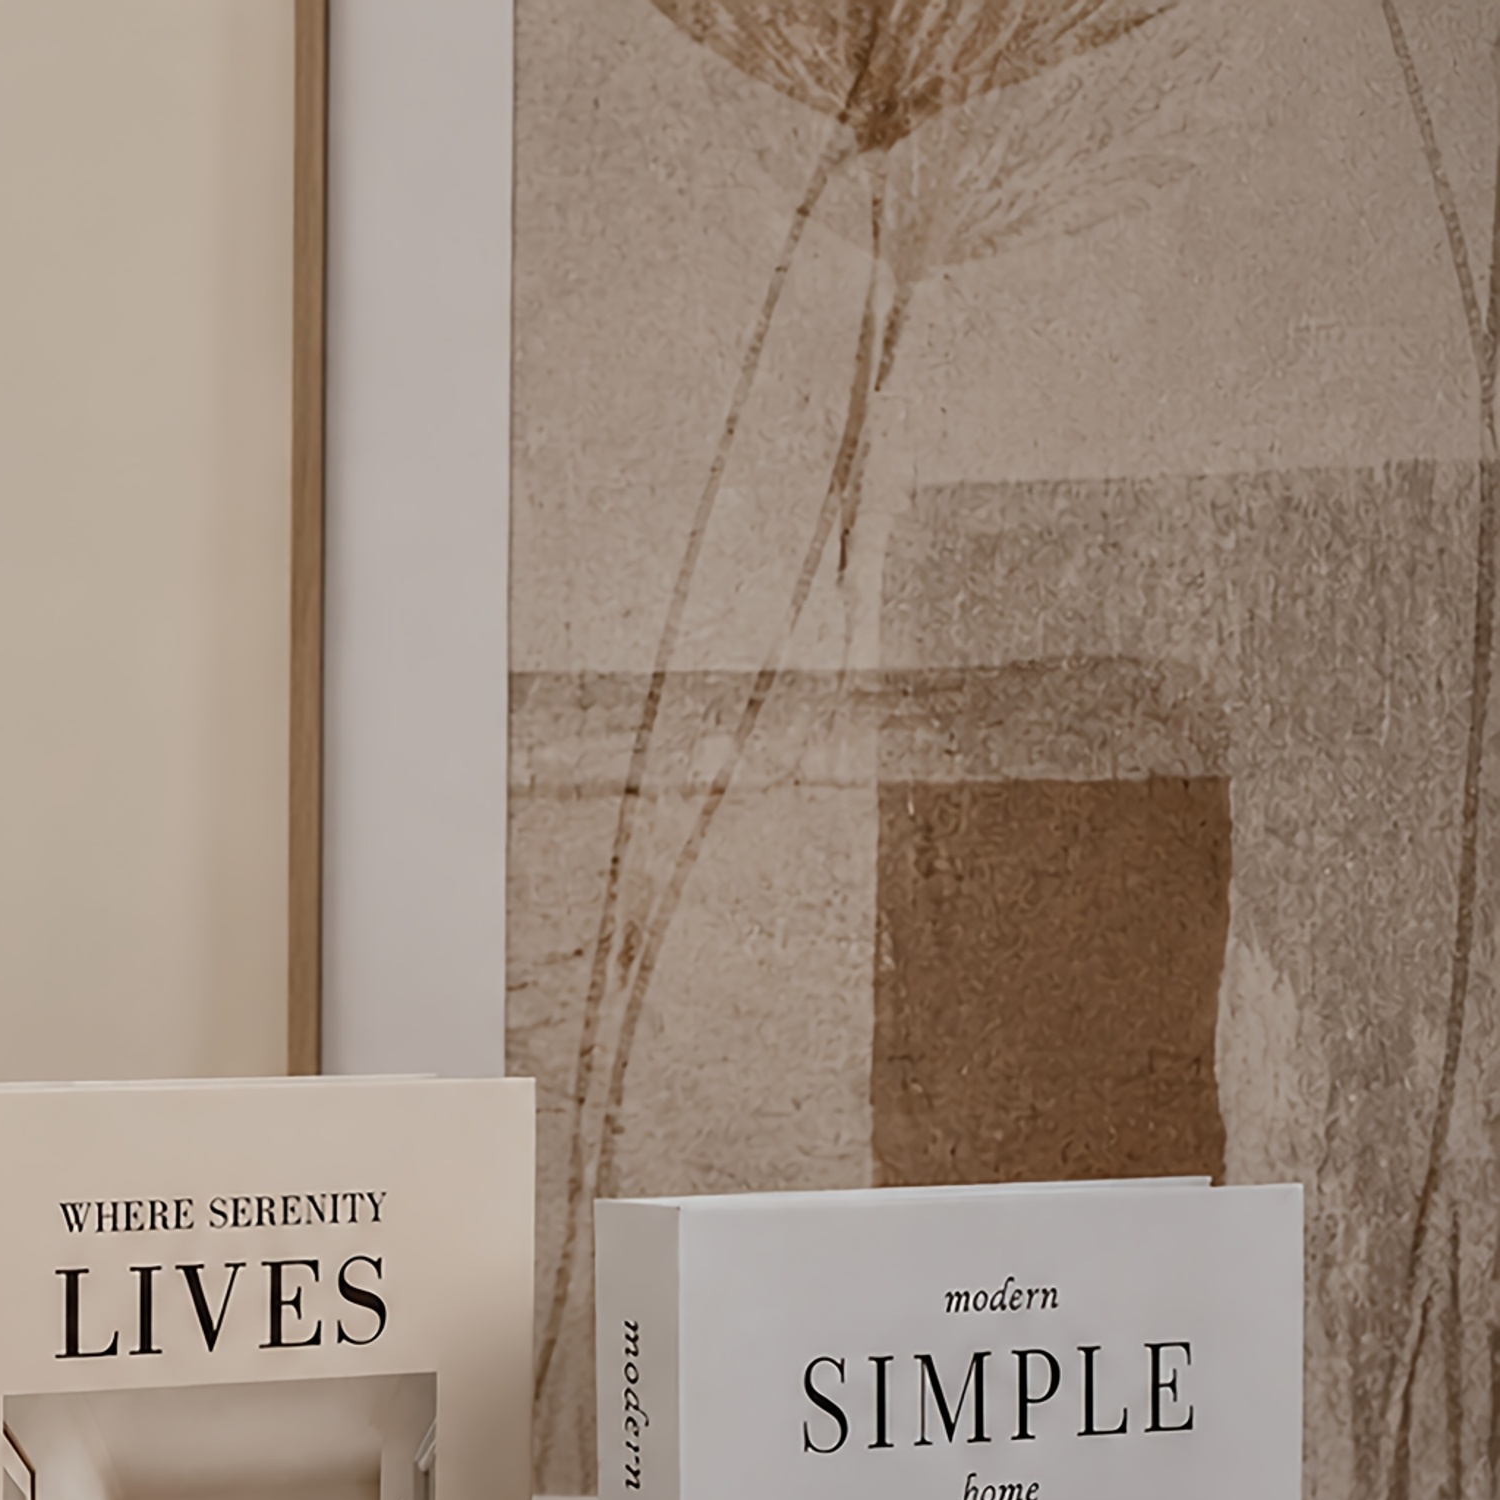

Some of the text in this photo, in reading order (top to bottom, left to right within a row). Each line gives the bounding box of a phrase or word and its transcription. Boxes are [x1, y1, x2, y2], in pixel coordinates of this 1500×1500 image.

[59, 1191, 387, 1233] WHERE SERENITY
[54, 1255, 387, 1359] LIVES
[944, 1276, 1059, 1314] modern
[623, 1320, 650, 1490] modern
[803, 1341, 1194, 1454] SIMPLE
